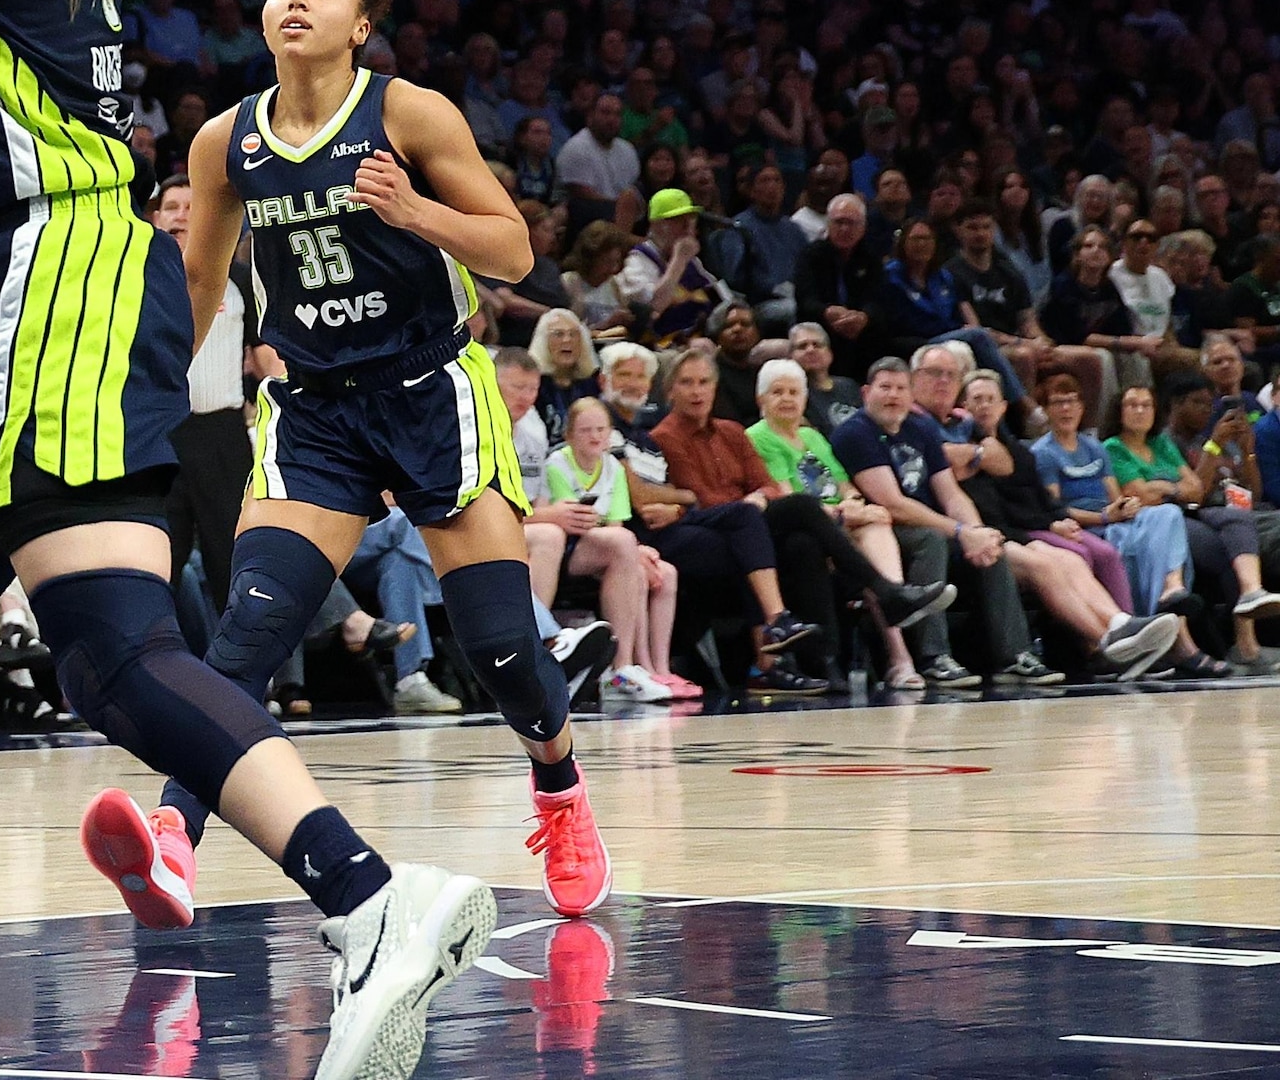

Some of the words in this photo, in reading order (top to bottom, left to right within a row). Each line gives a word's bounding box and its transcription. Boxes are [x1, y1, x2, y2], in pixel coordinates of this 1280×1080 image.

[330, 139, 371, 160] Albert
[288, 225, 354, 290] 35
[320, 291, 388, 327] CVS
